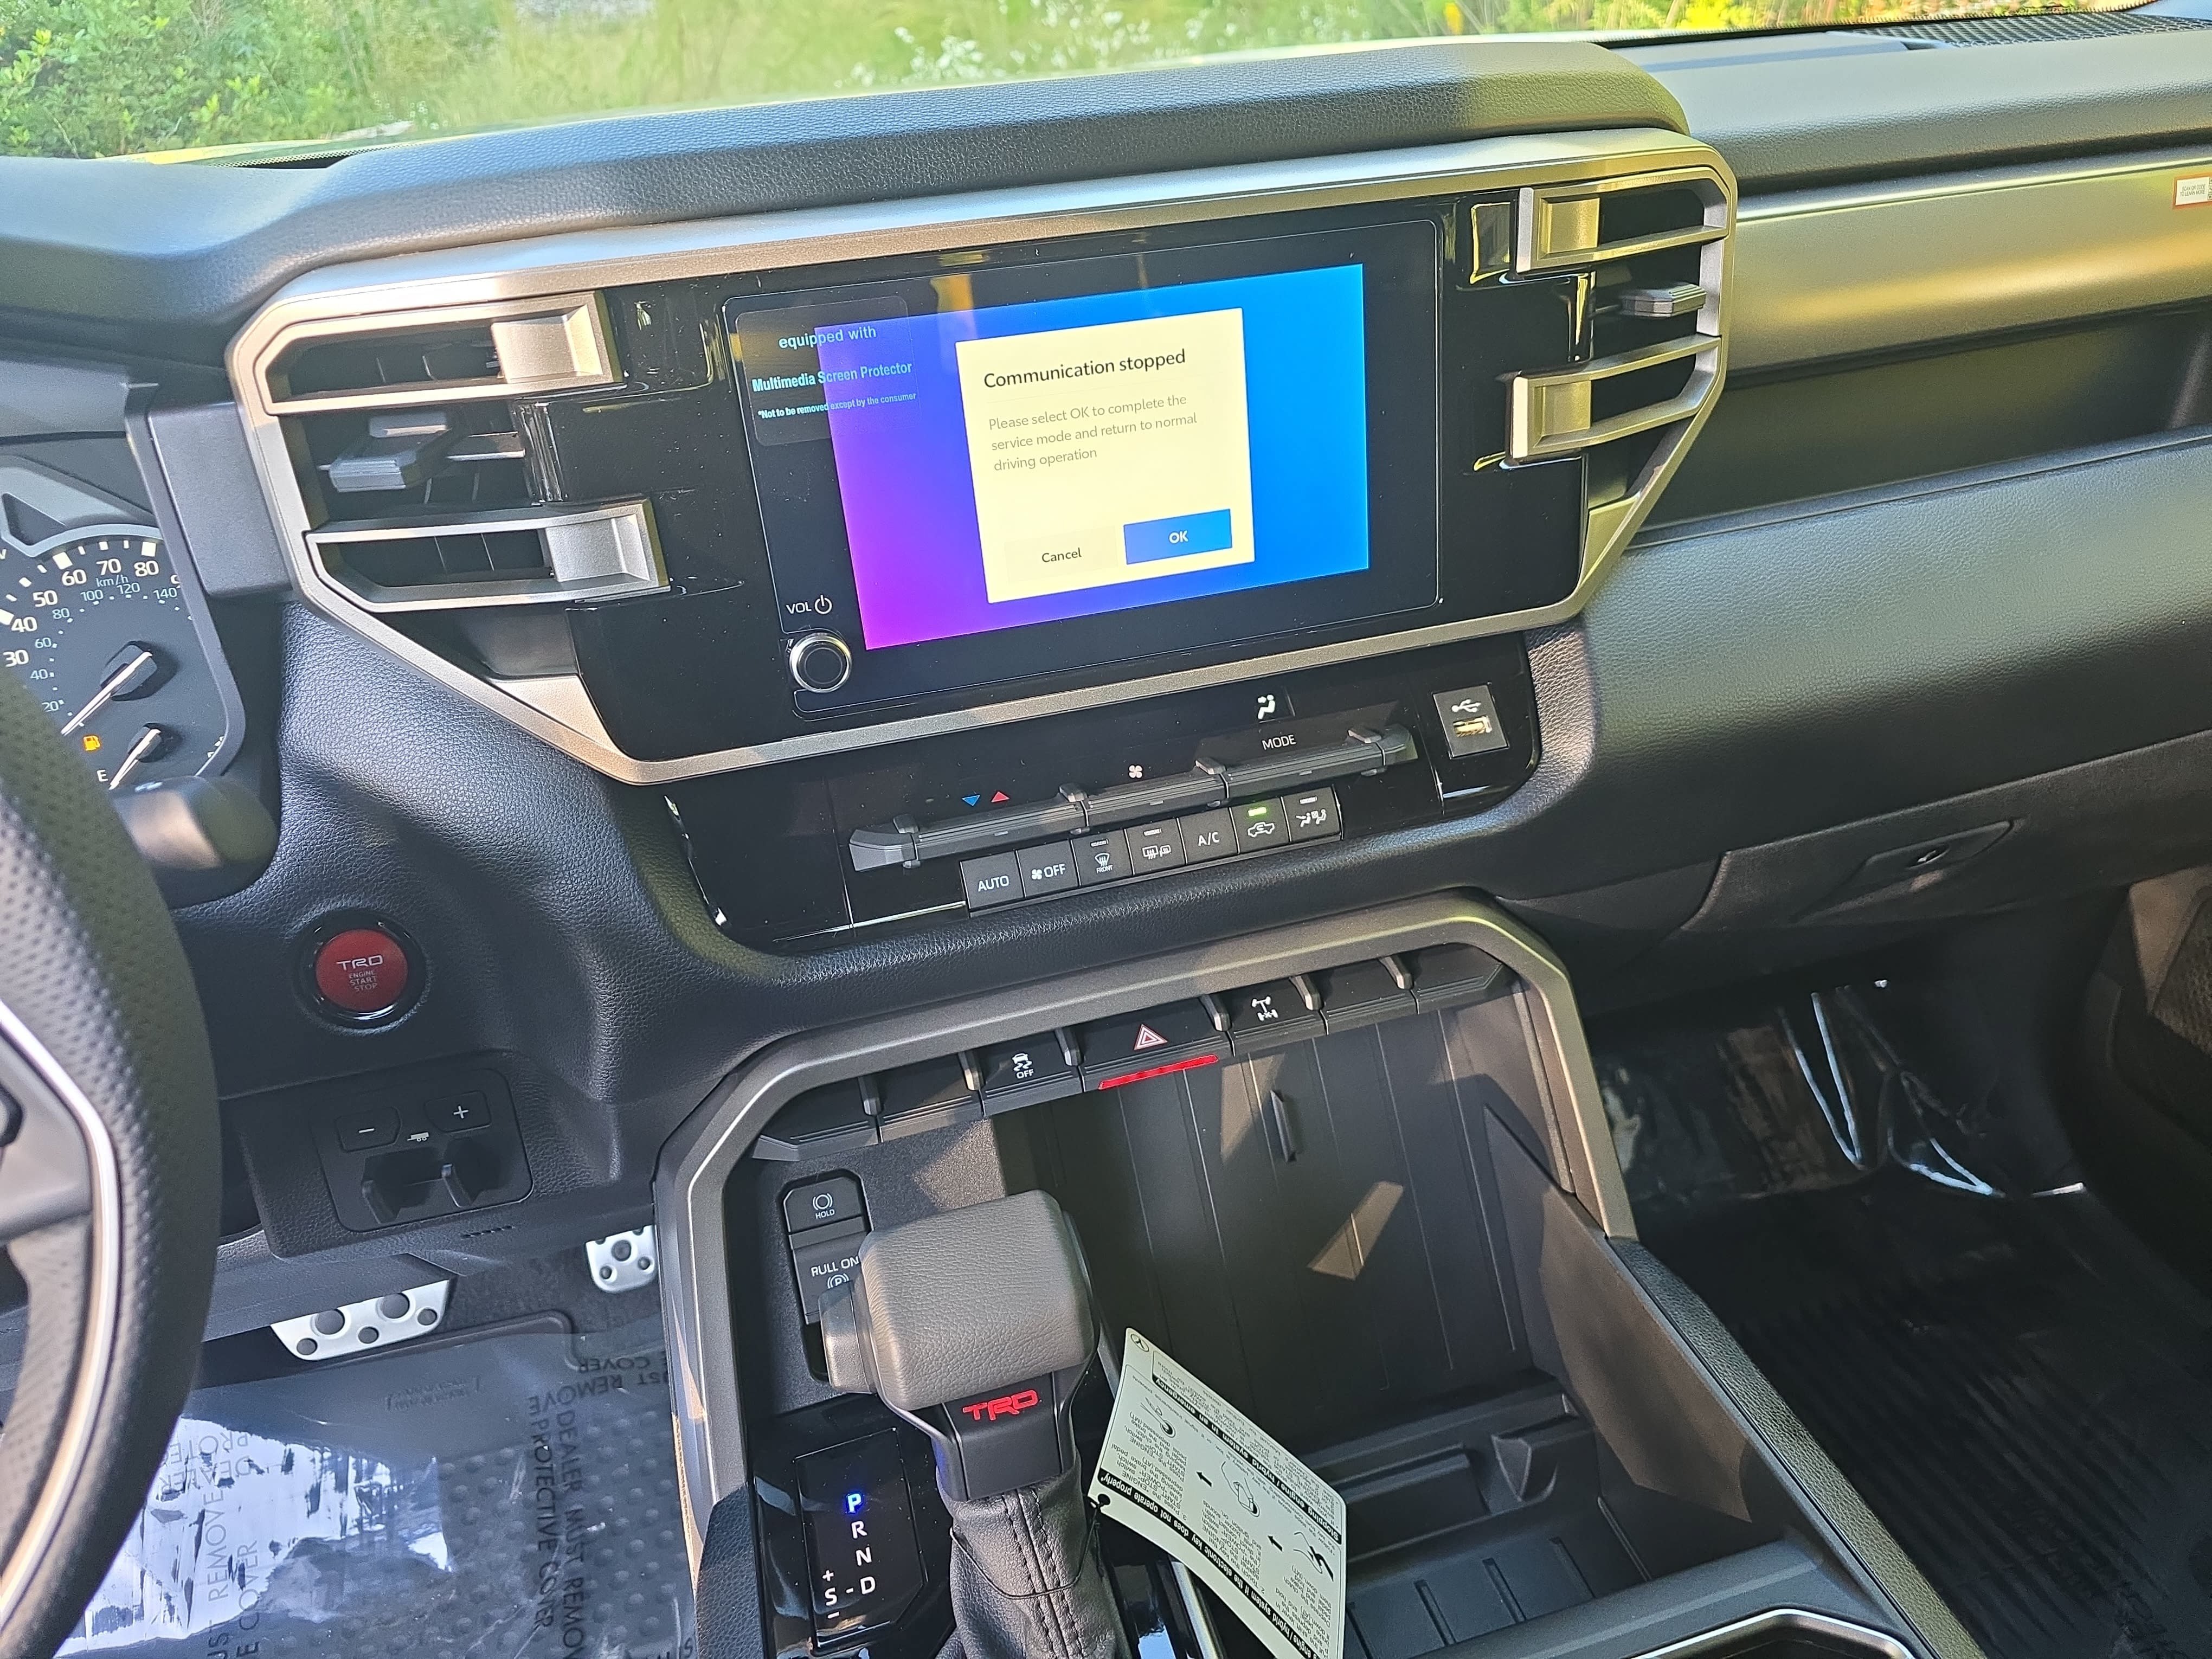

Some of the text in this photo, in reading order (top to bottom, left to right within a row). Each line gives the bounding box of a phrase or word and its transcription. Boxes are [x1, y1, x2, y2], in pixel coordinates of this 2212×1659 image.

[779, 325, 876, 350] equipped with
[984, 349, 1186, 388] Communication stopped
[752, 362, 912, 393] Multimedia Screen Protector
[776, 408, 785, 417] to
[786, 407, 796, 416] be
[796, 403, 828, 415] removed
[831, 399, 856, 411] except
[856, 397, 866, 409] by
[867, 396, 879, 406] the
[880, 392, 917, 404] consumer
[989, 394, 1187, 430] Please select OK to complete the
[992, 412, 1197, 451] service mode and return to normal
[994, 447, 1097, 471] driving operation
[1168, 530, 1189, 544] OK
[1041, 547, 1082, 563] Cancel
[97, 558, 122, 575] 70
[134, 561, 159, 576] 80
[62, 569, 87, 586] 60
[95, 574, 129, 588] km/h
[81, 589, 104, 602] 100
[117, 581, 140, 595] 120
[153, 587, 177, 599] 140
[33, 589, 58, 606] 50
[53, 607, 70, 620] 80
[786, 602, 812, 614] VOL
[11, 616, 37, 633] 40
[35, 637, 52, 648] 60
[4, 650, 29, 666] 30
[30, 668, 48, 680] 40
[42, 701, 59, 712] 20
[1262, 734, 1297, 750] MODE
[97, 769, 108, 782] E
[1197, 831, 1220, 847] A/C
[1044, 864, 1066, 878] OFF
[1096, 865, 1114, 873] FRONT
[978, 874, 1009, 892] AUTO
[336, 955, 383, 971] TRD
[349, 970, 375, 979] ENGINE
[350, 976, 377, 986] START
[354, 982, 377, 992] STOP
[1015, 1068, 1034, 1079] OFF
[815, 1208, 835, 1219] HOLD
[840, 1256, 859, 1269] ON
[578, 1356, 651, 1374] COVER
[962, 1390, 1040, 1420] TRD
[557, 1409, 583, 1492] DEALER
[1155, 1377, 1338, 1541] Stopping engine hybrid system in an emergency
[847, 1493, 862, 1513] P
[1133, 1490, 1159, 1513] operate
[529, 1419, 561, 1628] PROTECTIVE COVER
[1160, 1509, 1171, 1525] not
[565, 1509, 586, 1564] MUST
[851, 1520, 867, 1539] R
[1173, 1519, 1189, 1539] does
[202, 1488, 229, 1602] REMOVE
[1191, 1532, 1202, 1550] key
[856, 1546, 872, 1566] N
[1204, 1545, 1232, 1578] electronic
[1233, 1573, 1243, 1589] the
[824, 1576, 876, 1606] S D
[1244, 1584, 1249, 1596] if
[1251, 1590, 1271, 1616] system
[1272, 1611, 1289, 1638] hybrid
[1293, 1633, 1311, 1659] engine
